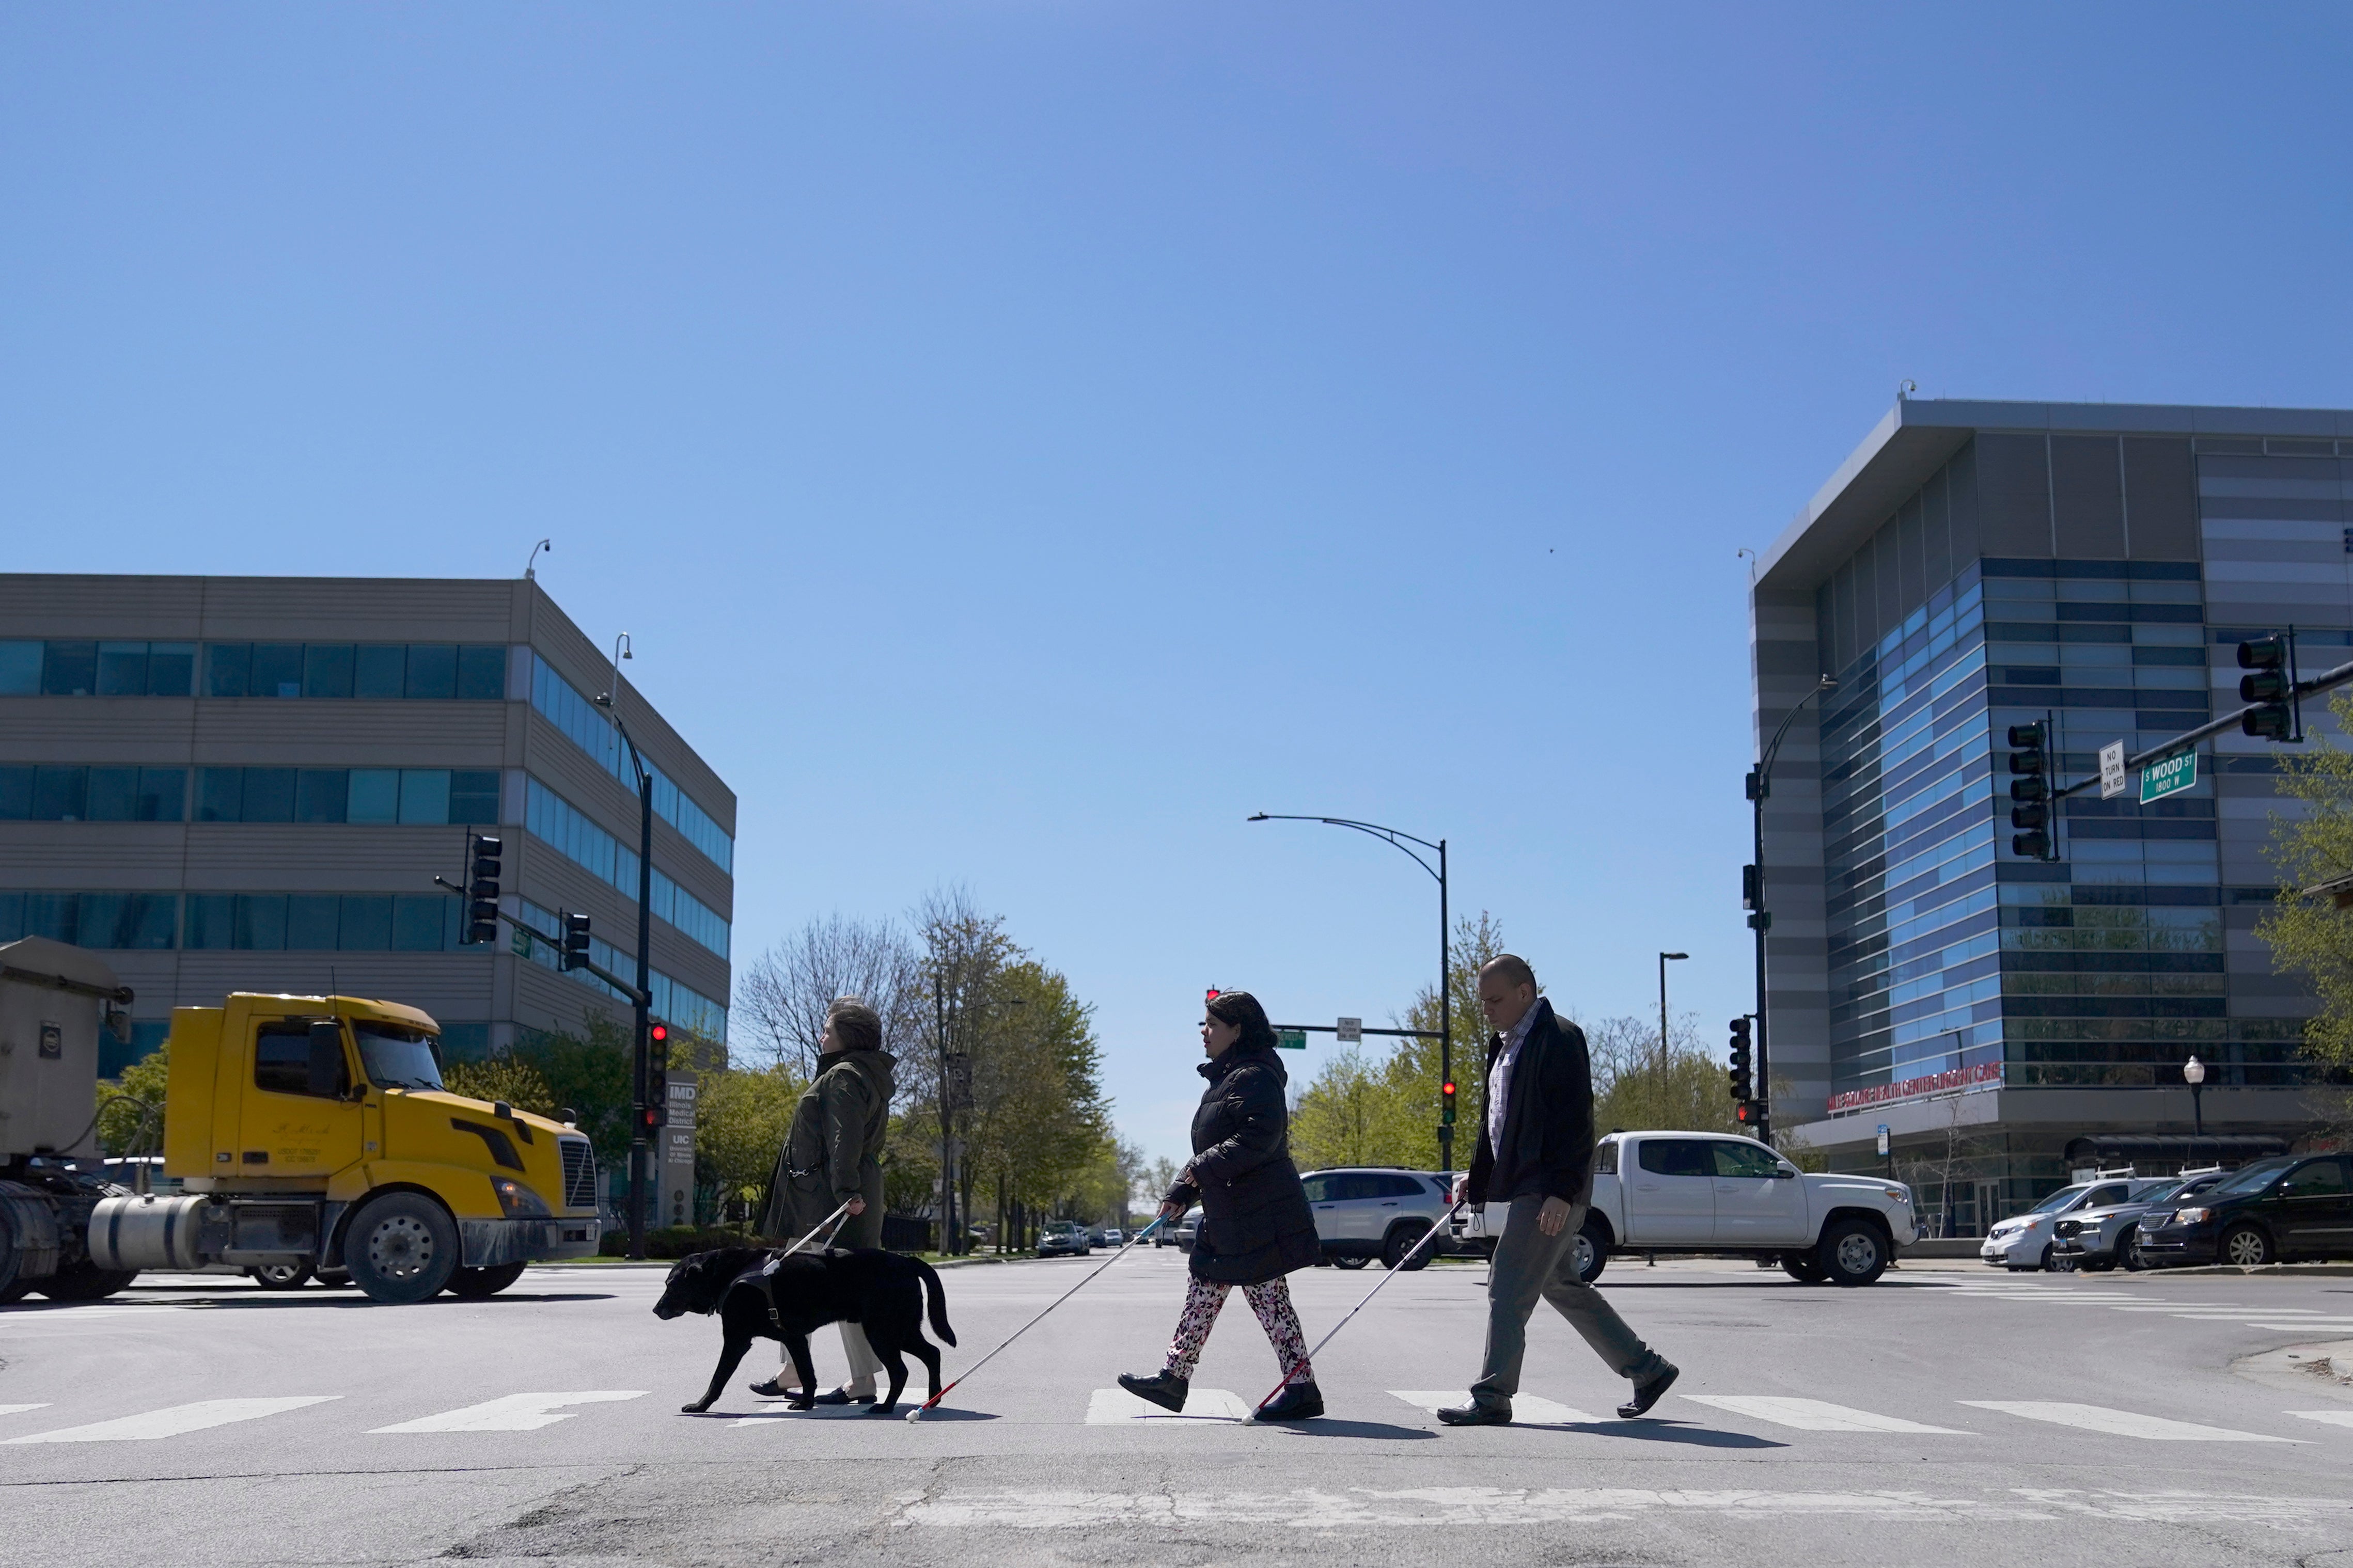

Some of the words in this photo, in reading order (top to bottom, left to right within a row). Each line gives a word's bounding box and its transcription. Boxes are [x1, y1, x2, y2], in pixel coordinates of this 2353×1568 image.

[2107, 750, 2115, 762] NO
[2106, 763, 2120, 777] TURN
[2145, 771, 2150, 782] S
[2152, 757, 2182, 781] WOOD
[2184, 754, 2192, 767] ST
[2103, 781, 2110, 791] ON
[2113, 776, 2123, 788] RED
[2156, 778, 2170, 793] 1800
[2174, 775, 2179, 786] W
[1875, 1082, 1901, 1101] HEALTH
[1903, 1073, 1936, 1096] CENTER
[1937, 1066, 1972, 1090] URGENT
[1975, 1060, 2000, 1082] CARE
[669, 1086, 695, 1099] IMD
[673, 1135, 689, 1144] UIC
